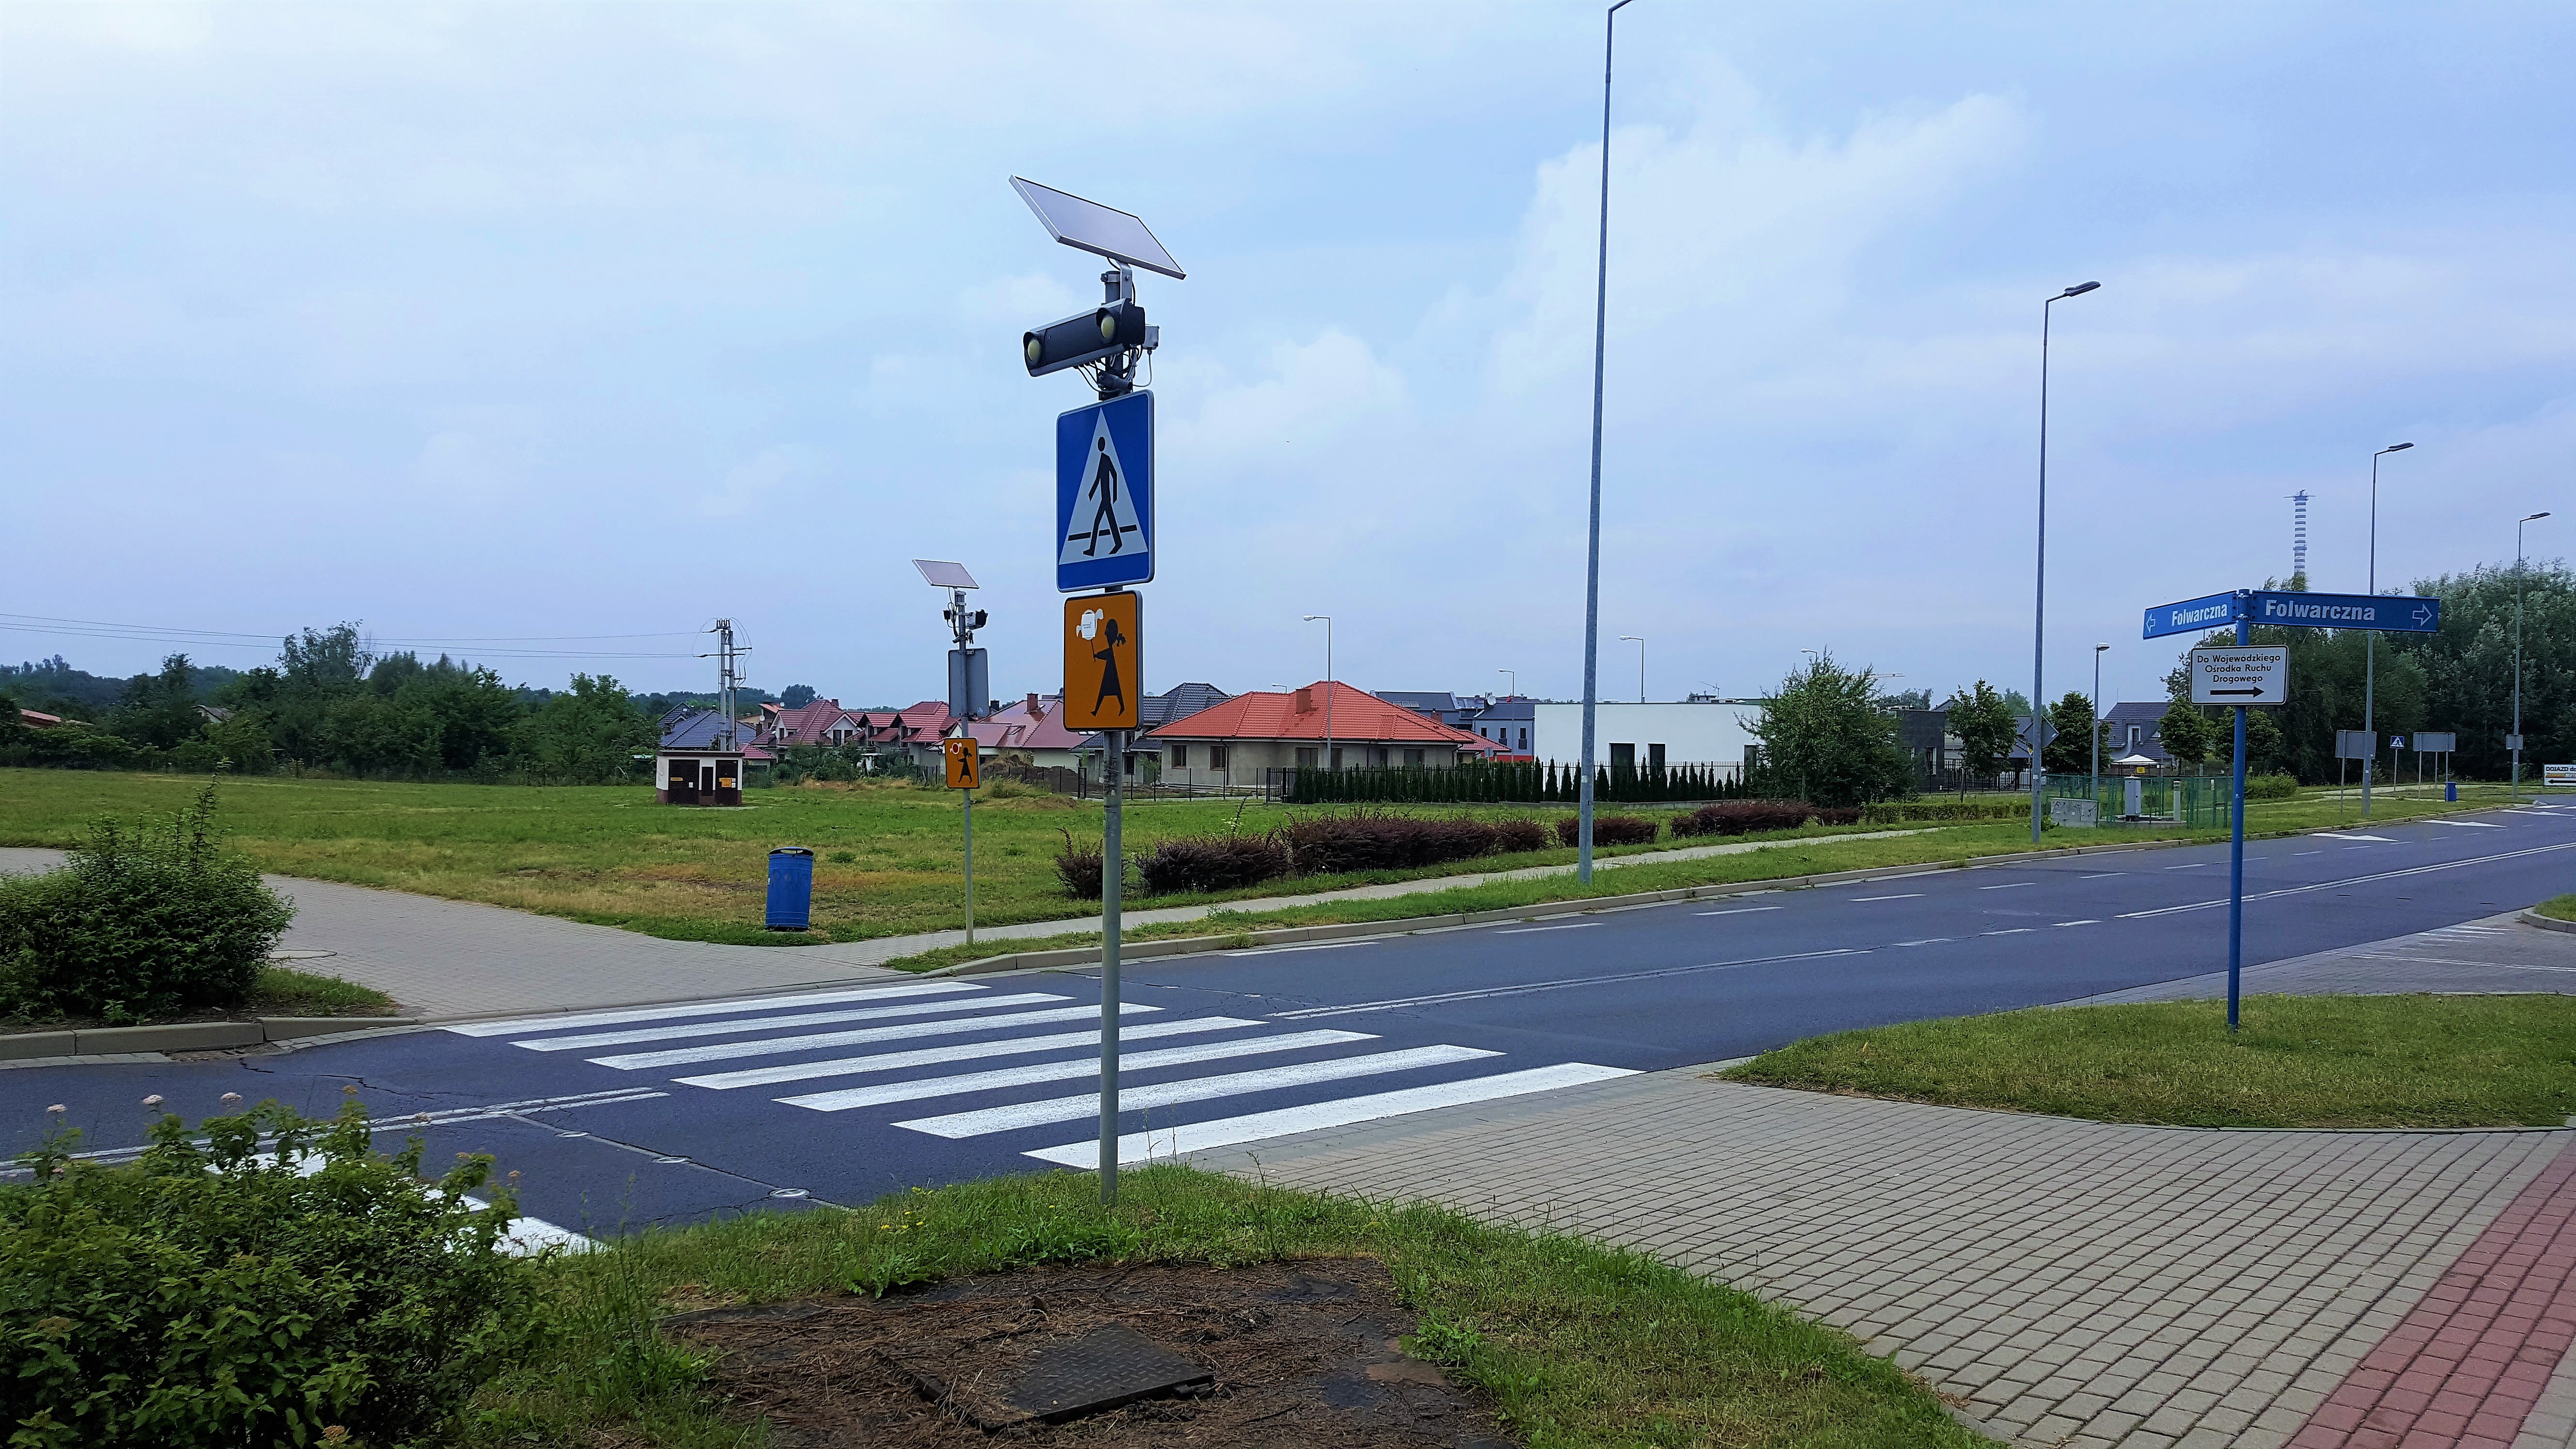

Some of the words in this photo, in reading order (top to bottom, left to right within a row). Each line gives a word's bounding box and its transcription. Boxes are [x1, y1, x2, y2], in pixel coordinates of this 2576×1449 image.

[2266, 599, 2375, 621] Folwarczna
[2172, 604, 2228, 627] Folwarczna
[2212, 654, 2281, 664] Wojewódzkiego
[2205, 664, 2241, 673] Ośrodka
[2245, 664, 2271, 672] Ruchu
[2213, 675, 2263, 684] Drogowego
